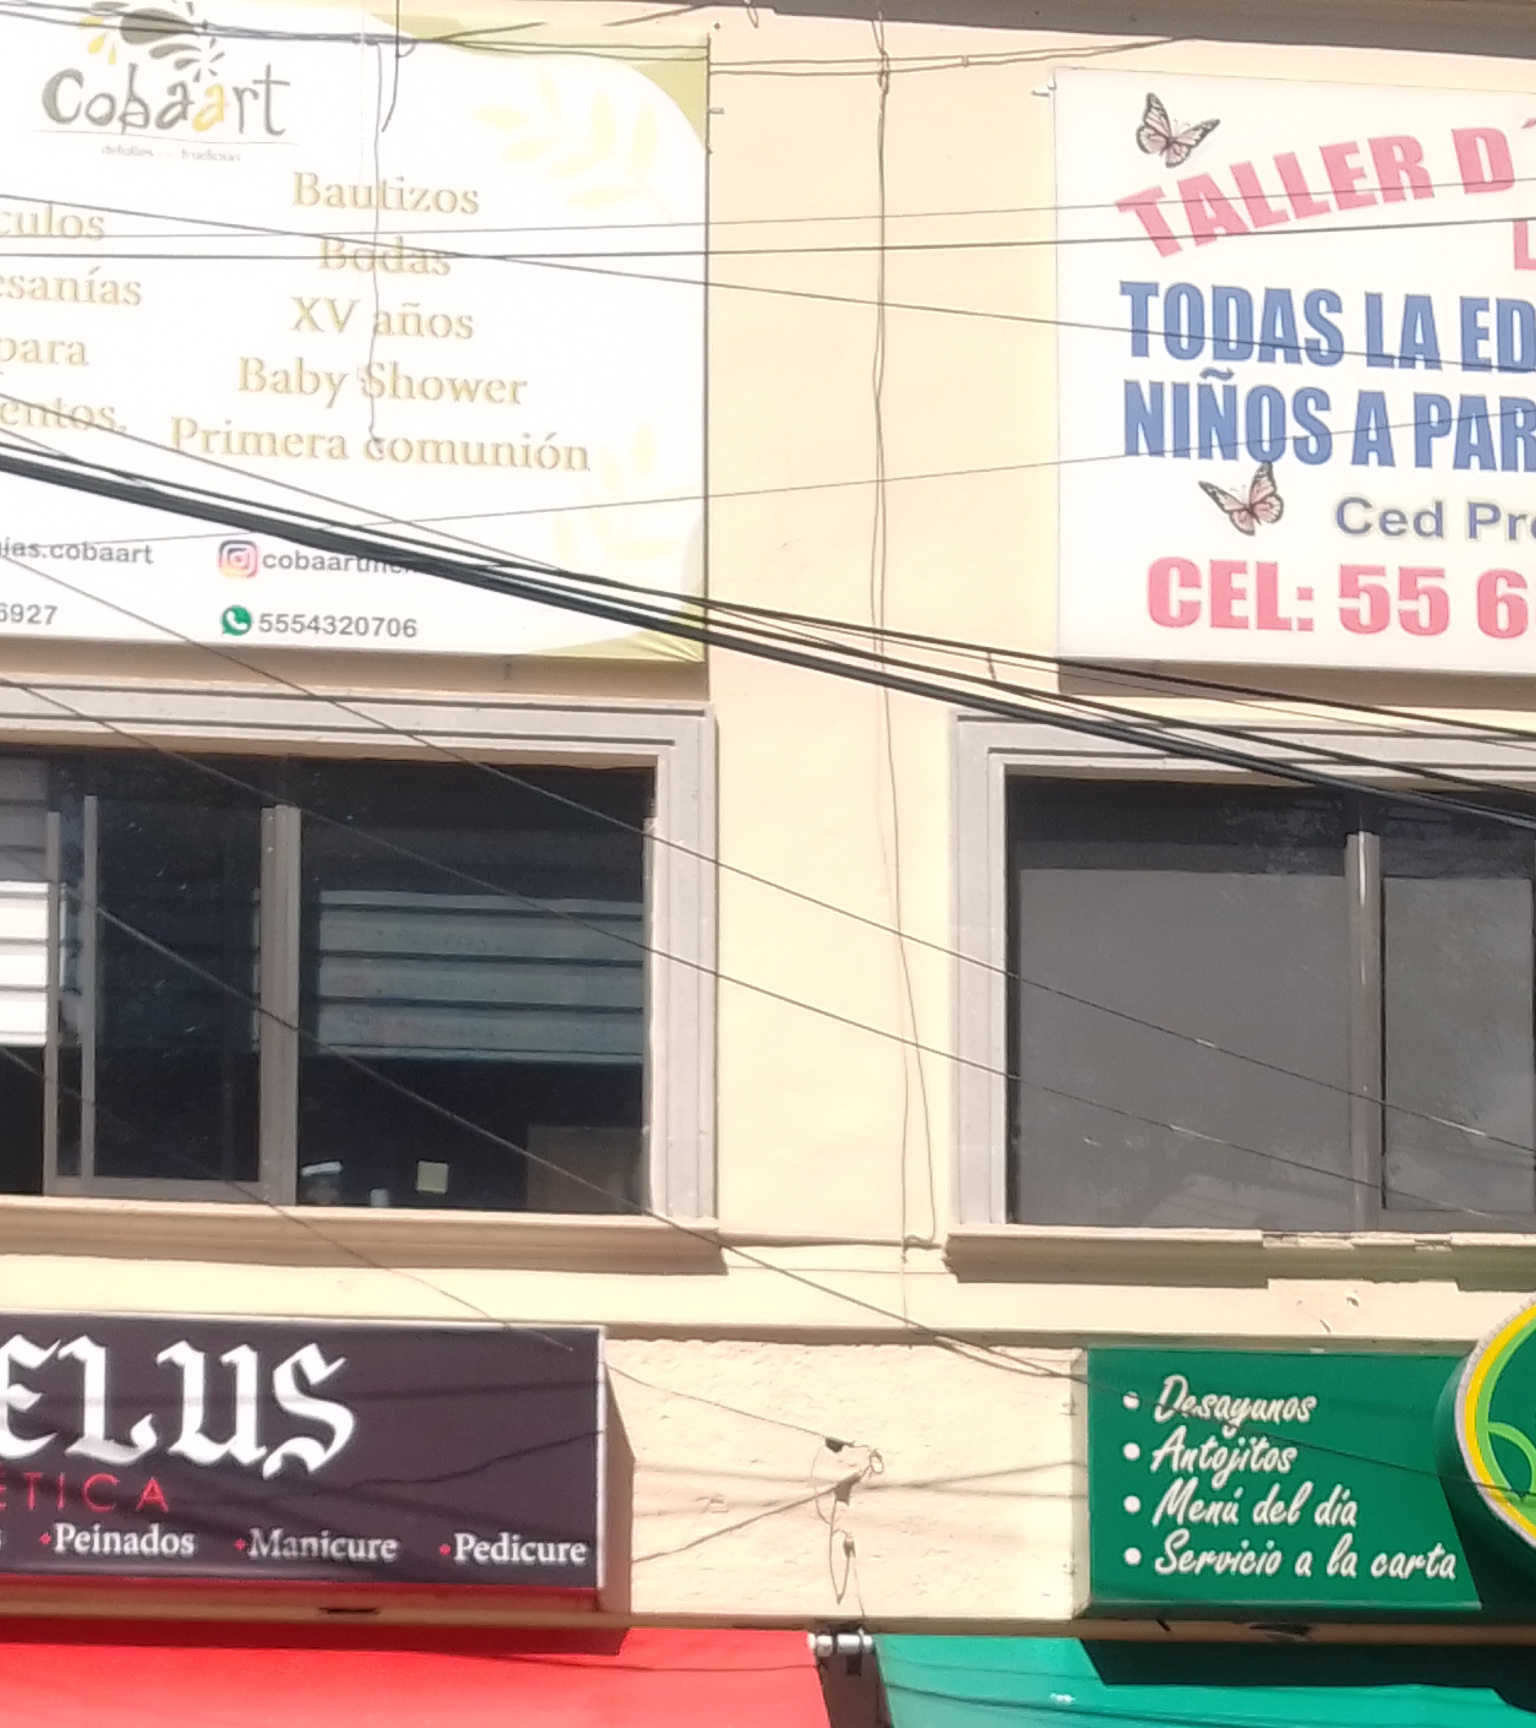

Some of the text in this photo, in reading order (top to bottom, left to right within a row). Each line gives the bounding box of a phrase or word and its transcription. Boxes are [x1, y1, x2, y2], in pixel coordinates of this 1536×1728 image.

[41, 62, 291, 136] Cobaart
[292, 171, 480, 215] Bautizos
[1115, 135, 1435, 258] TALLER
[318, 235, 452, 277] Bodas
[289, 296, 475, 340] XV años
[1119, 280, 1346, 366] TODAS
[1364, 291, 1442, 370] LA
[238, 356, 529, 410] Baby Shower
[170, 416, 591, 472] Primera comunión
[1123, 367, 1334, 466] NIÑOS
[1350, 389, 1396, 468] A
[1334, 495, 1445, 540] Ced
[1146, 555, 1315, 633] CEL:
[1338, 563, 1451, 637] 55
[259, 612, 420, 638] 5554320706
[1154, 1373, 1318, 1438] Desayunos
[1150, 1424, 1298, 1490] Antojitos
[1152, 1476, 1358, 1527] Menú del día
[53, 1523, 196, 1557] Peinados
[247, 1530, 400, 1563] Manicure
[454, 1533, 588, 1566] Pedicure
[1154, 1527, 1458, 1580] Servicio a la carta
